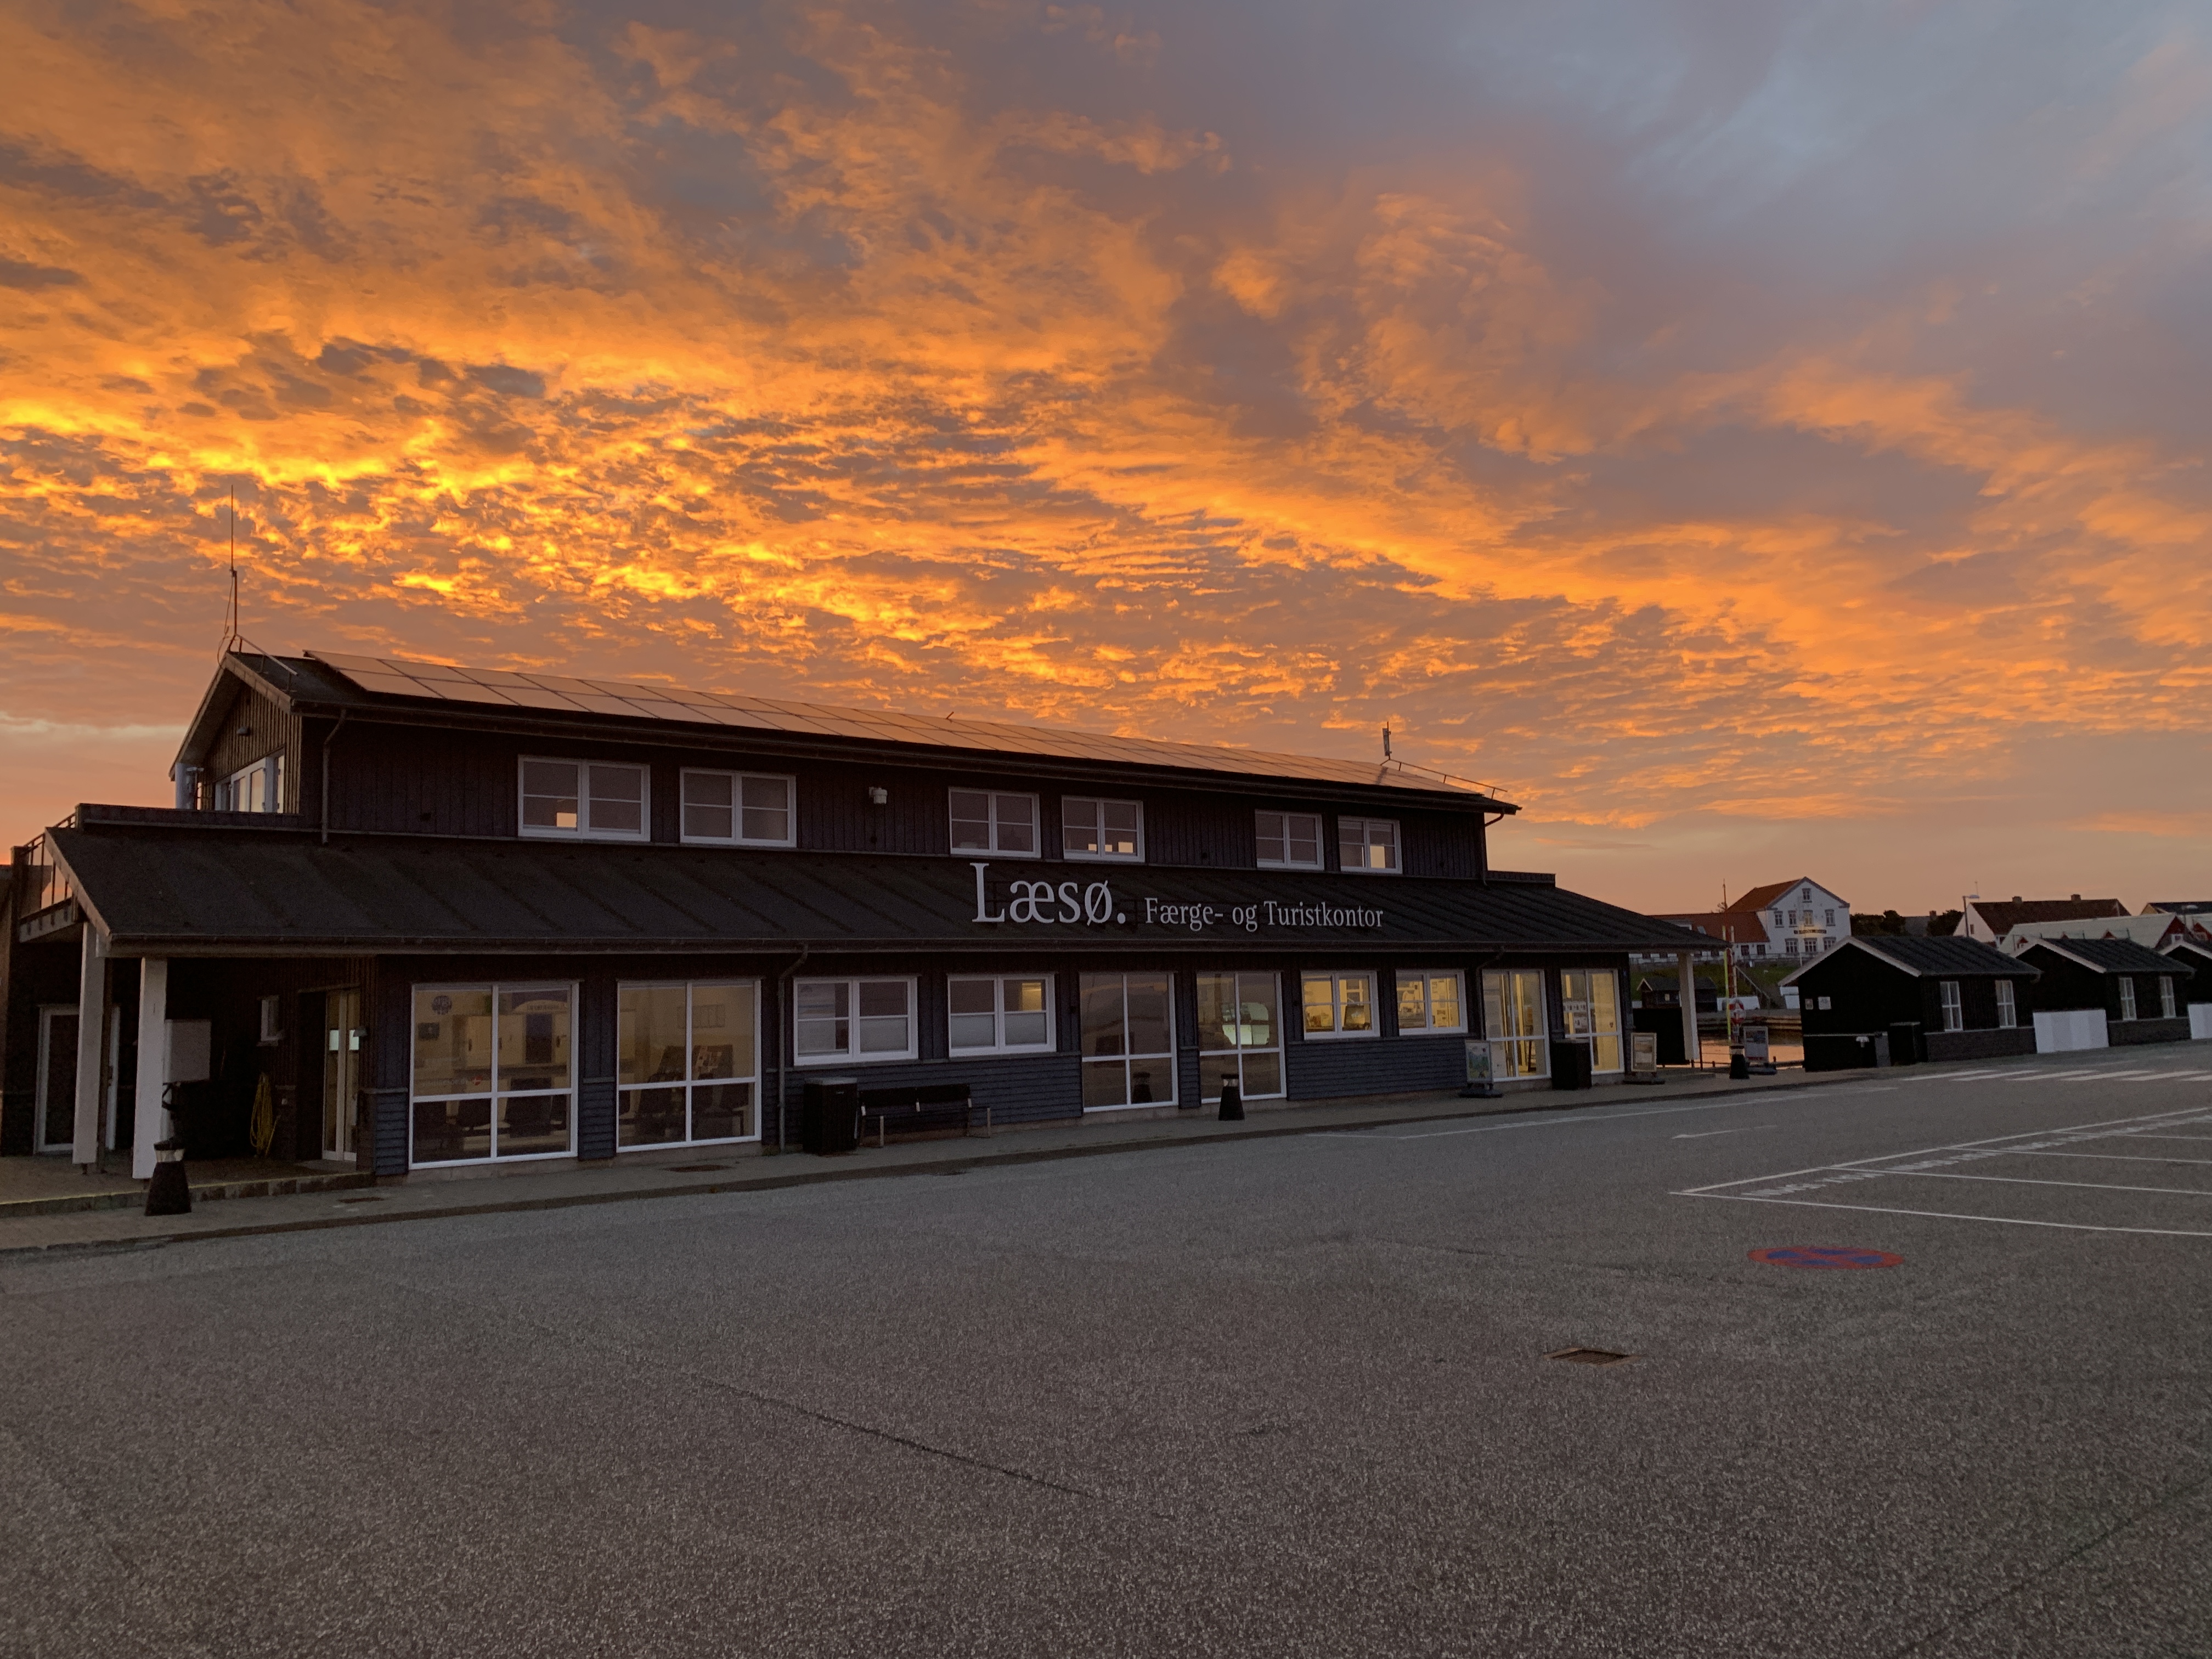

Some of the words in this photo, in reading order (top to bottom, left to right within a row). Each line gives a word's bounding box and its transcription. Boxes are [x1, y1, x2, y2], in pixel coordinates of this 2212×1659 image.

[969, 862, 1126, 926] Læsø.
[1144, 897, 1223, 932] Færge-
[1232, 904, 1258, 932] og
[1263, 901, 1384, 927] Turistkontor
